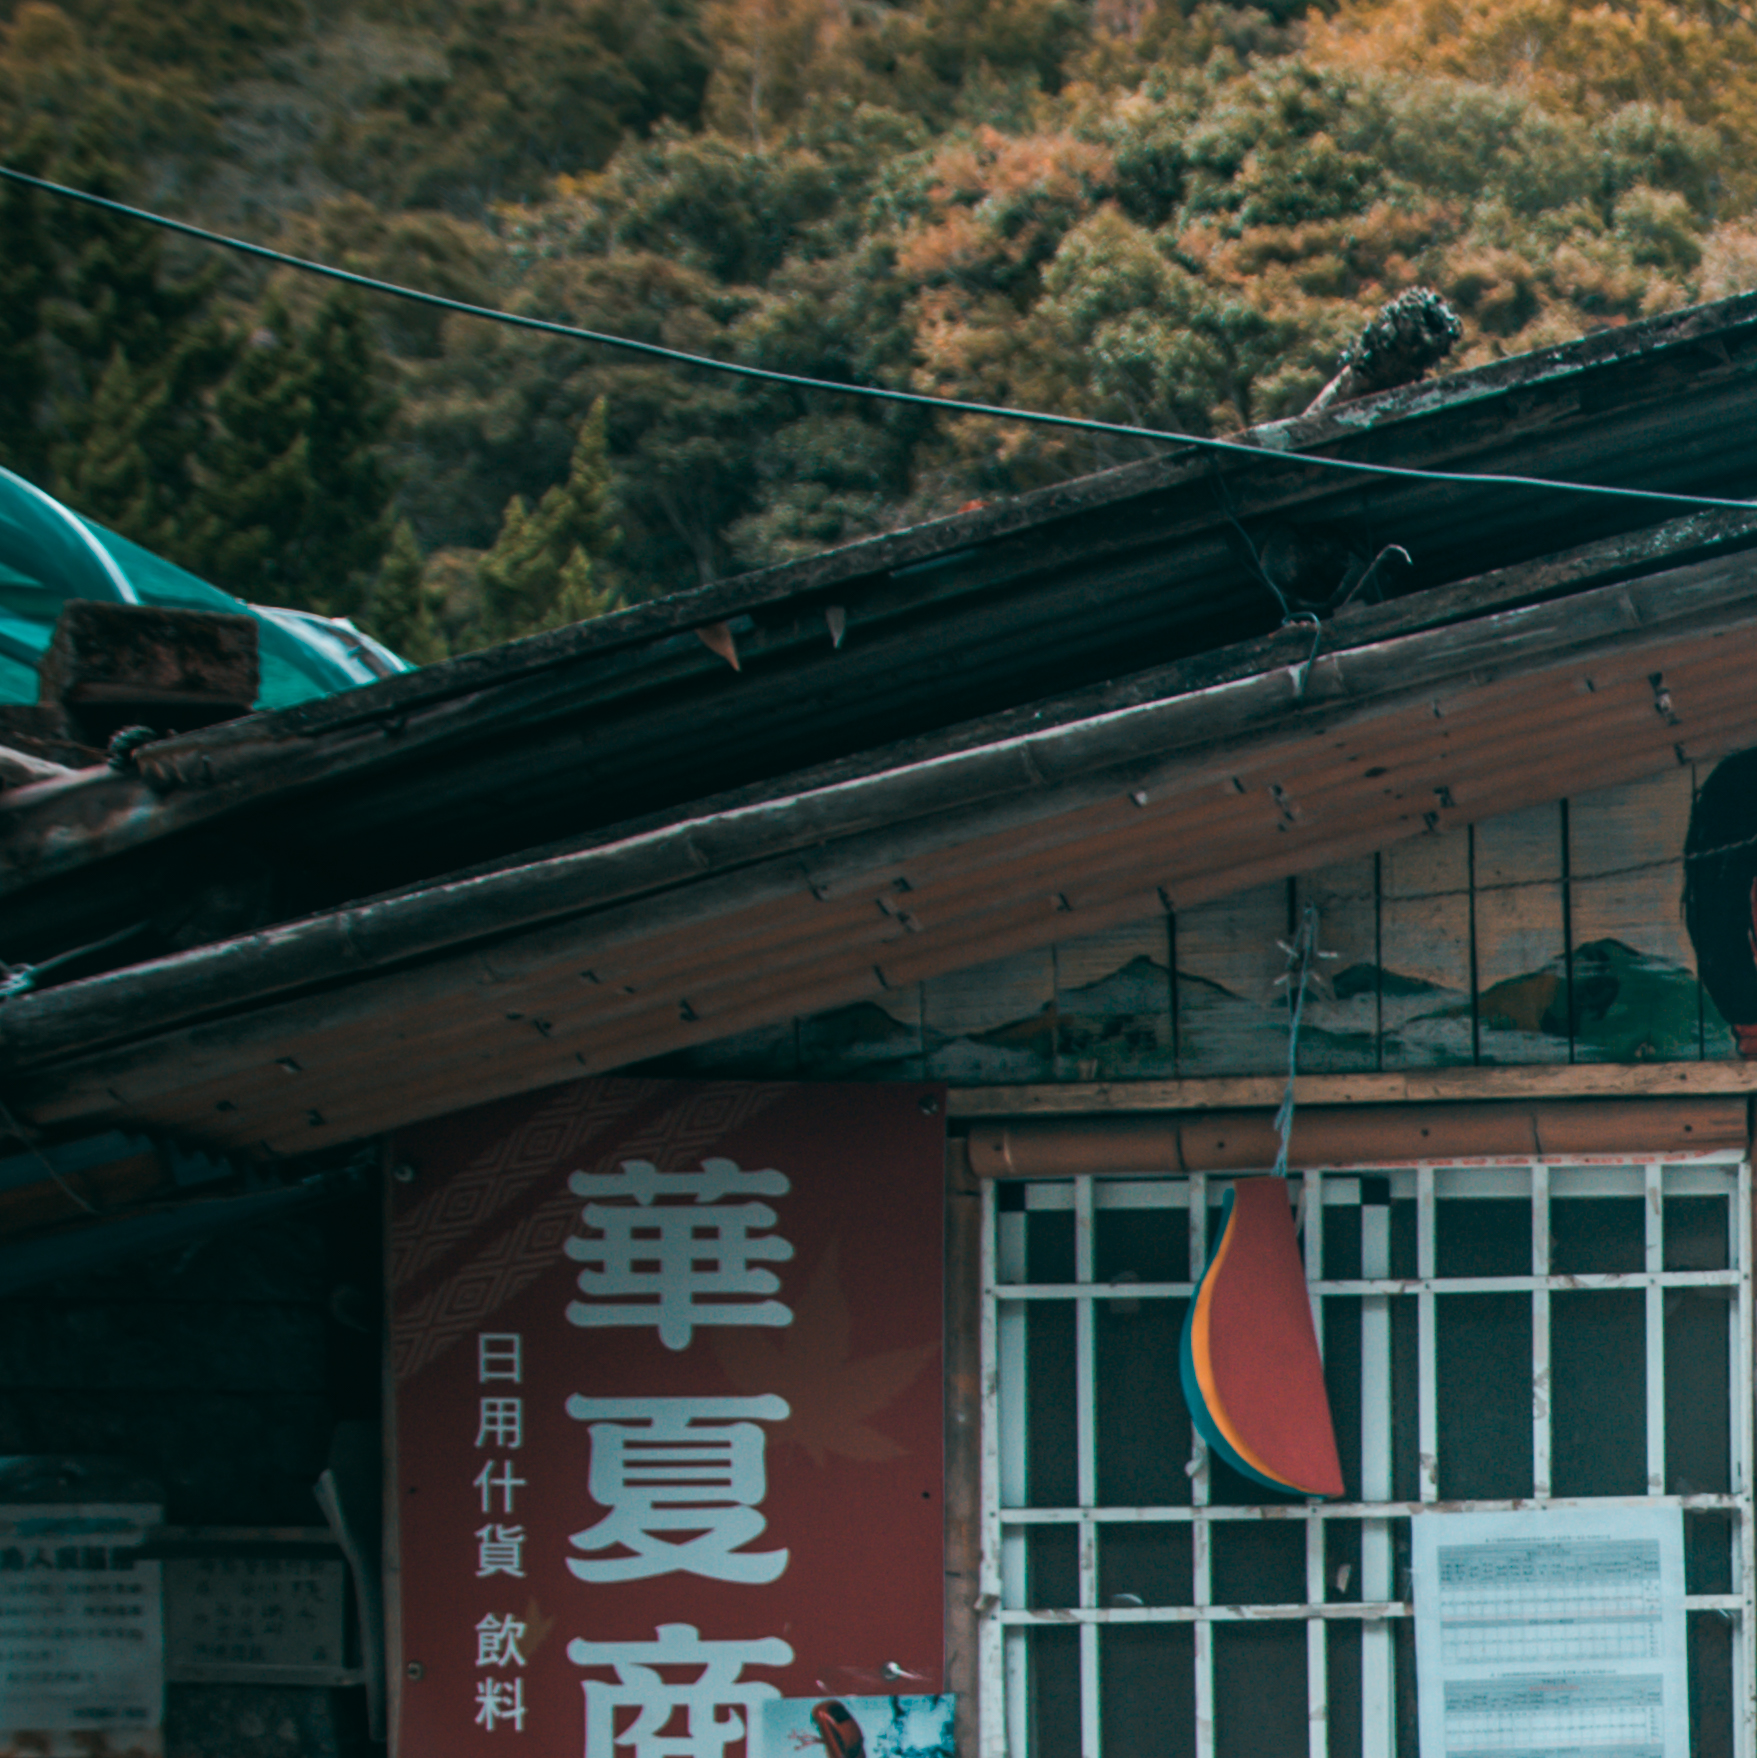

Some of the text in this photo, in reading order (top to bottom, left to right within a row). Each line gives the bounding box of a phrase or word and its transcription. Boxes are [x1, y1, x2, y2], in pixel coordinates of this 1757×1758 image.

[472, 1331, 525, 1578] 日用什貨
[473, 1613, 527, 1732] 飲料
